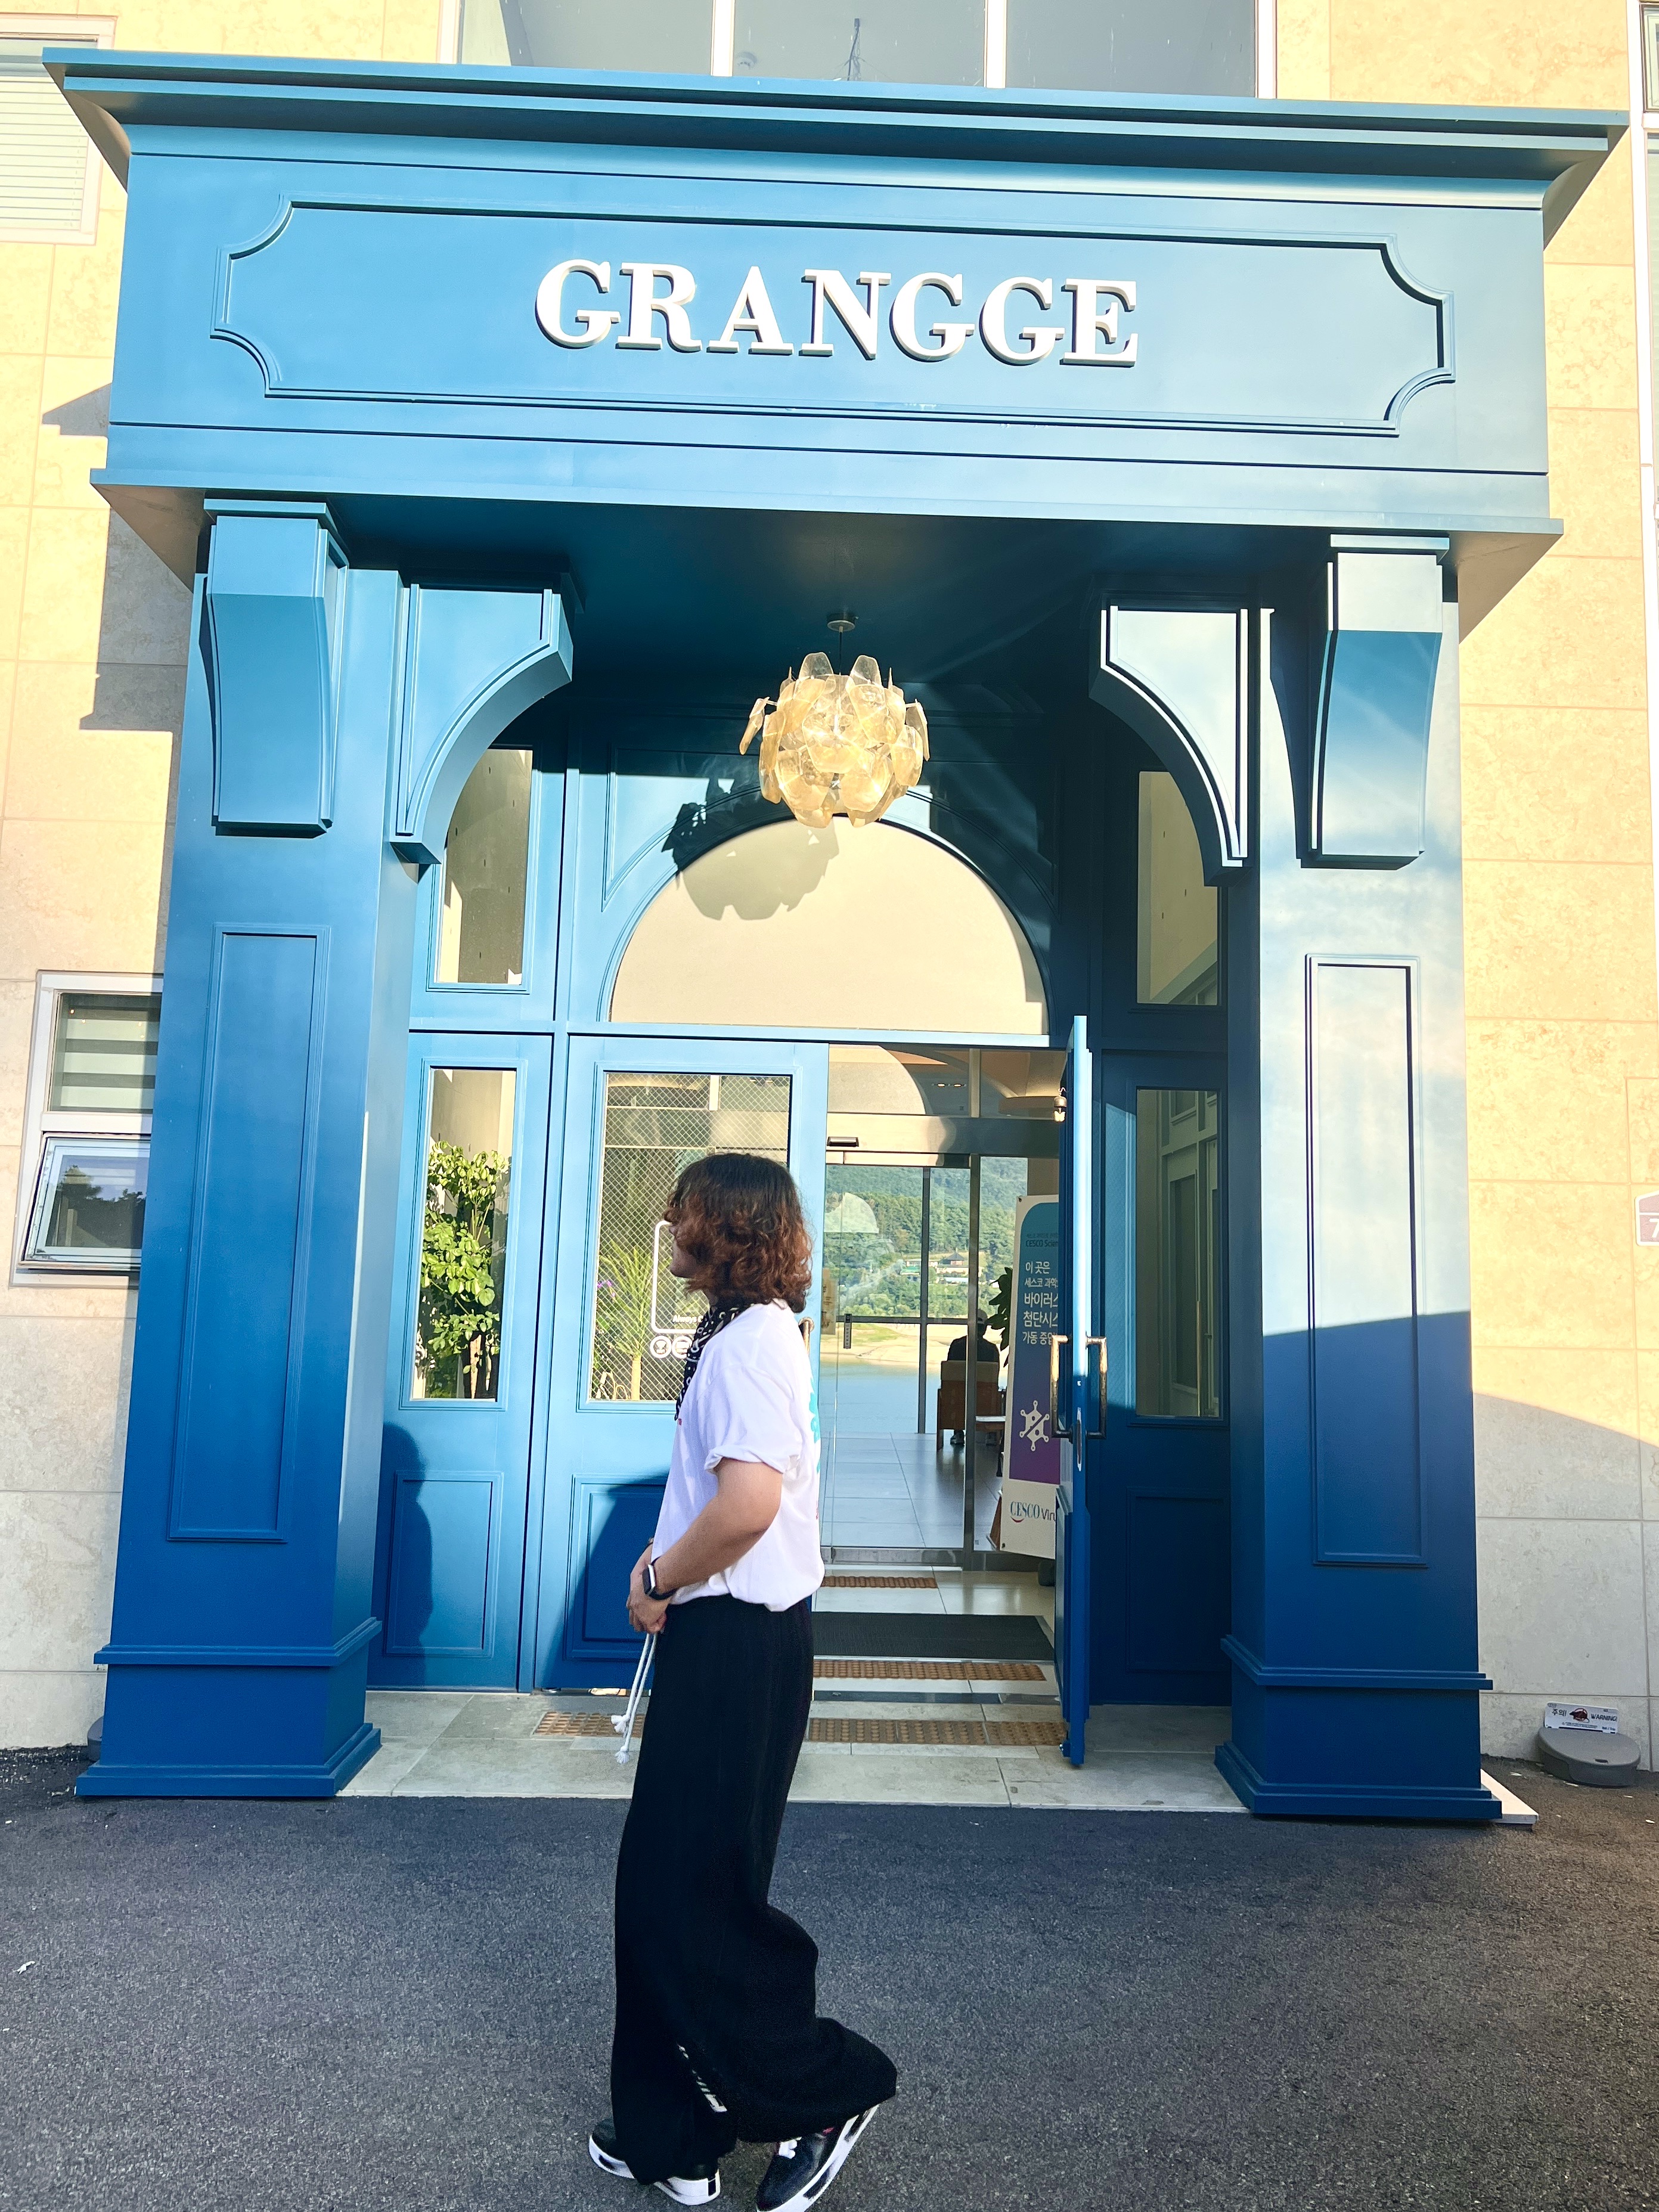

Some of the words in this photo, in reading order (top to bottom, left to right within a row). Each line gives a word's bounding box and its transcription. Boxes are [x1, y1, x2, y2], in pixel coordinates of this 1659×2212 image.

[535, 258, 1139, 367] GRANGGE
[1025, 1261, 1033, 1274] 이
[1035, 1261, 1050, 1274] 곳은
[1025, 1277, 1043, 1288] 세스코
[1044, 1277, 1058, 1288] 과학
[1022, 1331, 1038, 1345] 가동
[1010, 1501, 1040, 1519] CESCO
